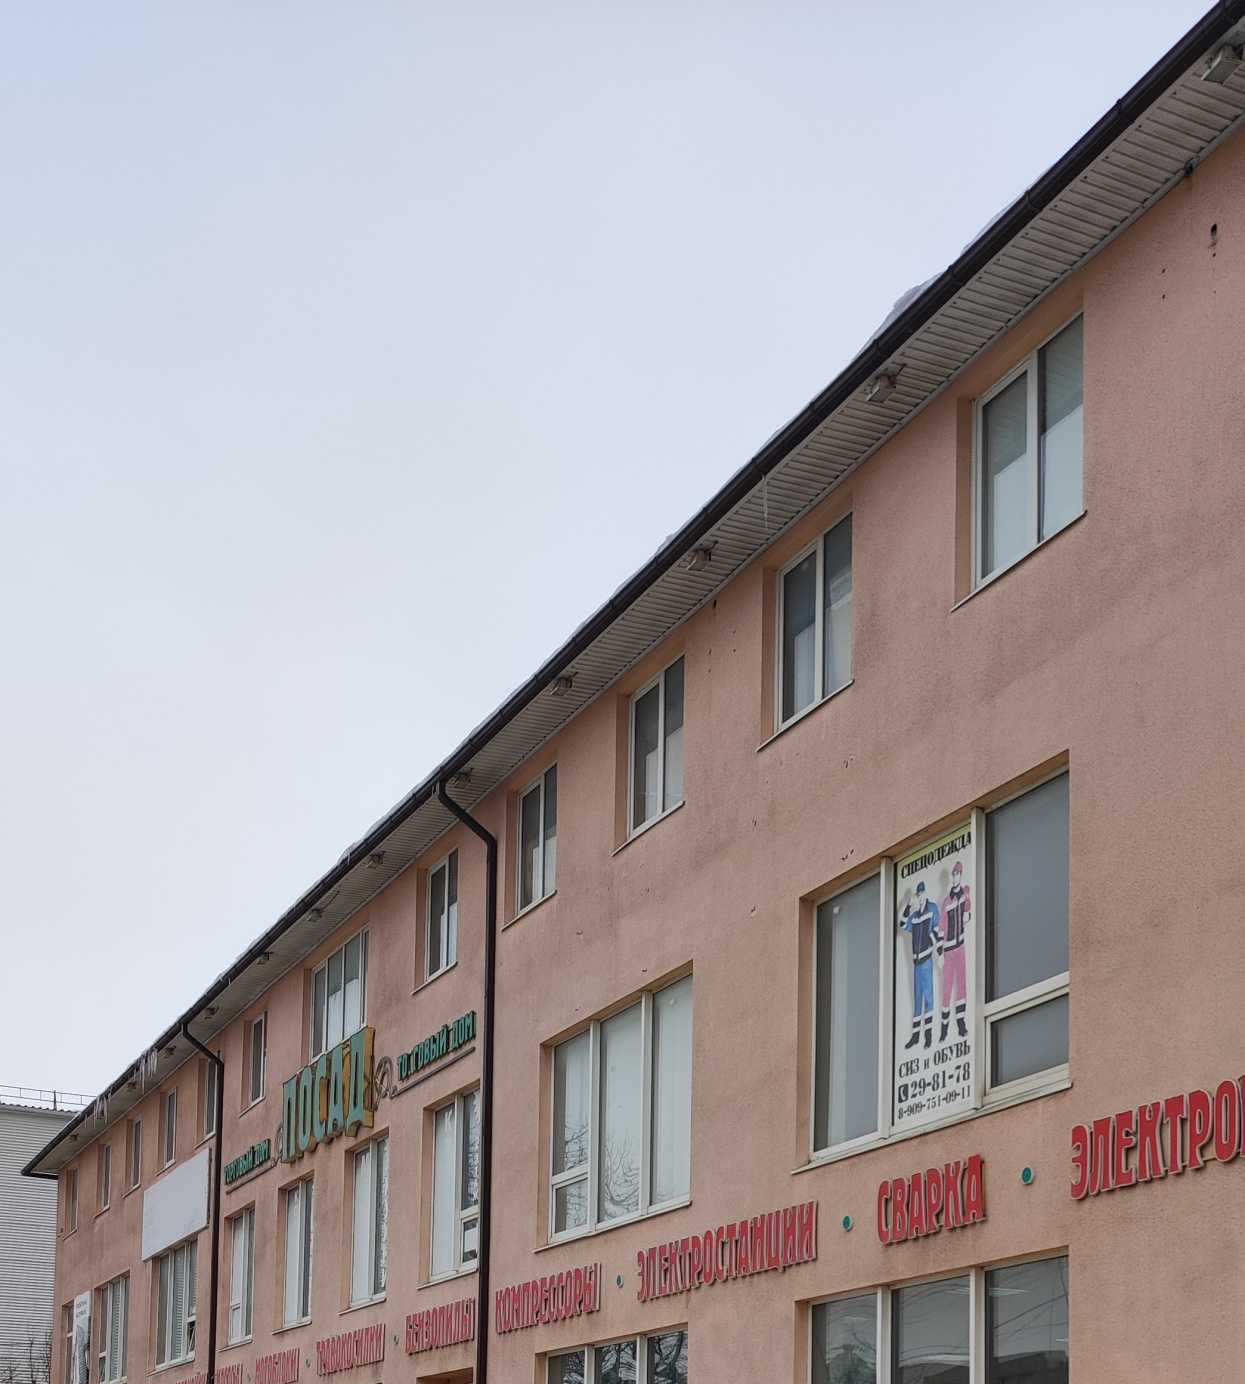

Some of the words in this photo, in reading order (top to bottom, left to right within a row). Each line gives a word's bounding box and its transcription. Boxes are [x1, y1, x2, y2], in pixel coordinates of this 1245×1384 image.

[901, 832, 971, 879] СПЕЦОДЕЖДА
[449, 1010, 477, 1052] ДОМ
[899, 1058, 920, 1079] СИЗ
[933, 1040, 970, 1066] ОБУВЬ
[910, 1062, 970, 1099] 29-81-78
[280, 1026, 375, 1163] ПОСАД
[898, 1085, 970, 1120] 8-909-751-09-11
[316, 1323, 386, 1376] ТРАВОКОСИЛКИ
[405, 1297, 476, 1355] БЕНЗОПИЛЫ
[495, 1262, 602, 1333] КОМПРЕССОРЫ
[636, 1200, 819, 1303] ЭЛЕКТРОСТАНЦИИ
[877, 1154, 987, 1245] СВАРКА
[1071, 1074, 1245, 1201] ЭЛЕКТРО
